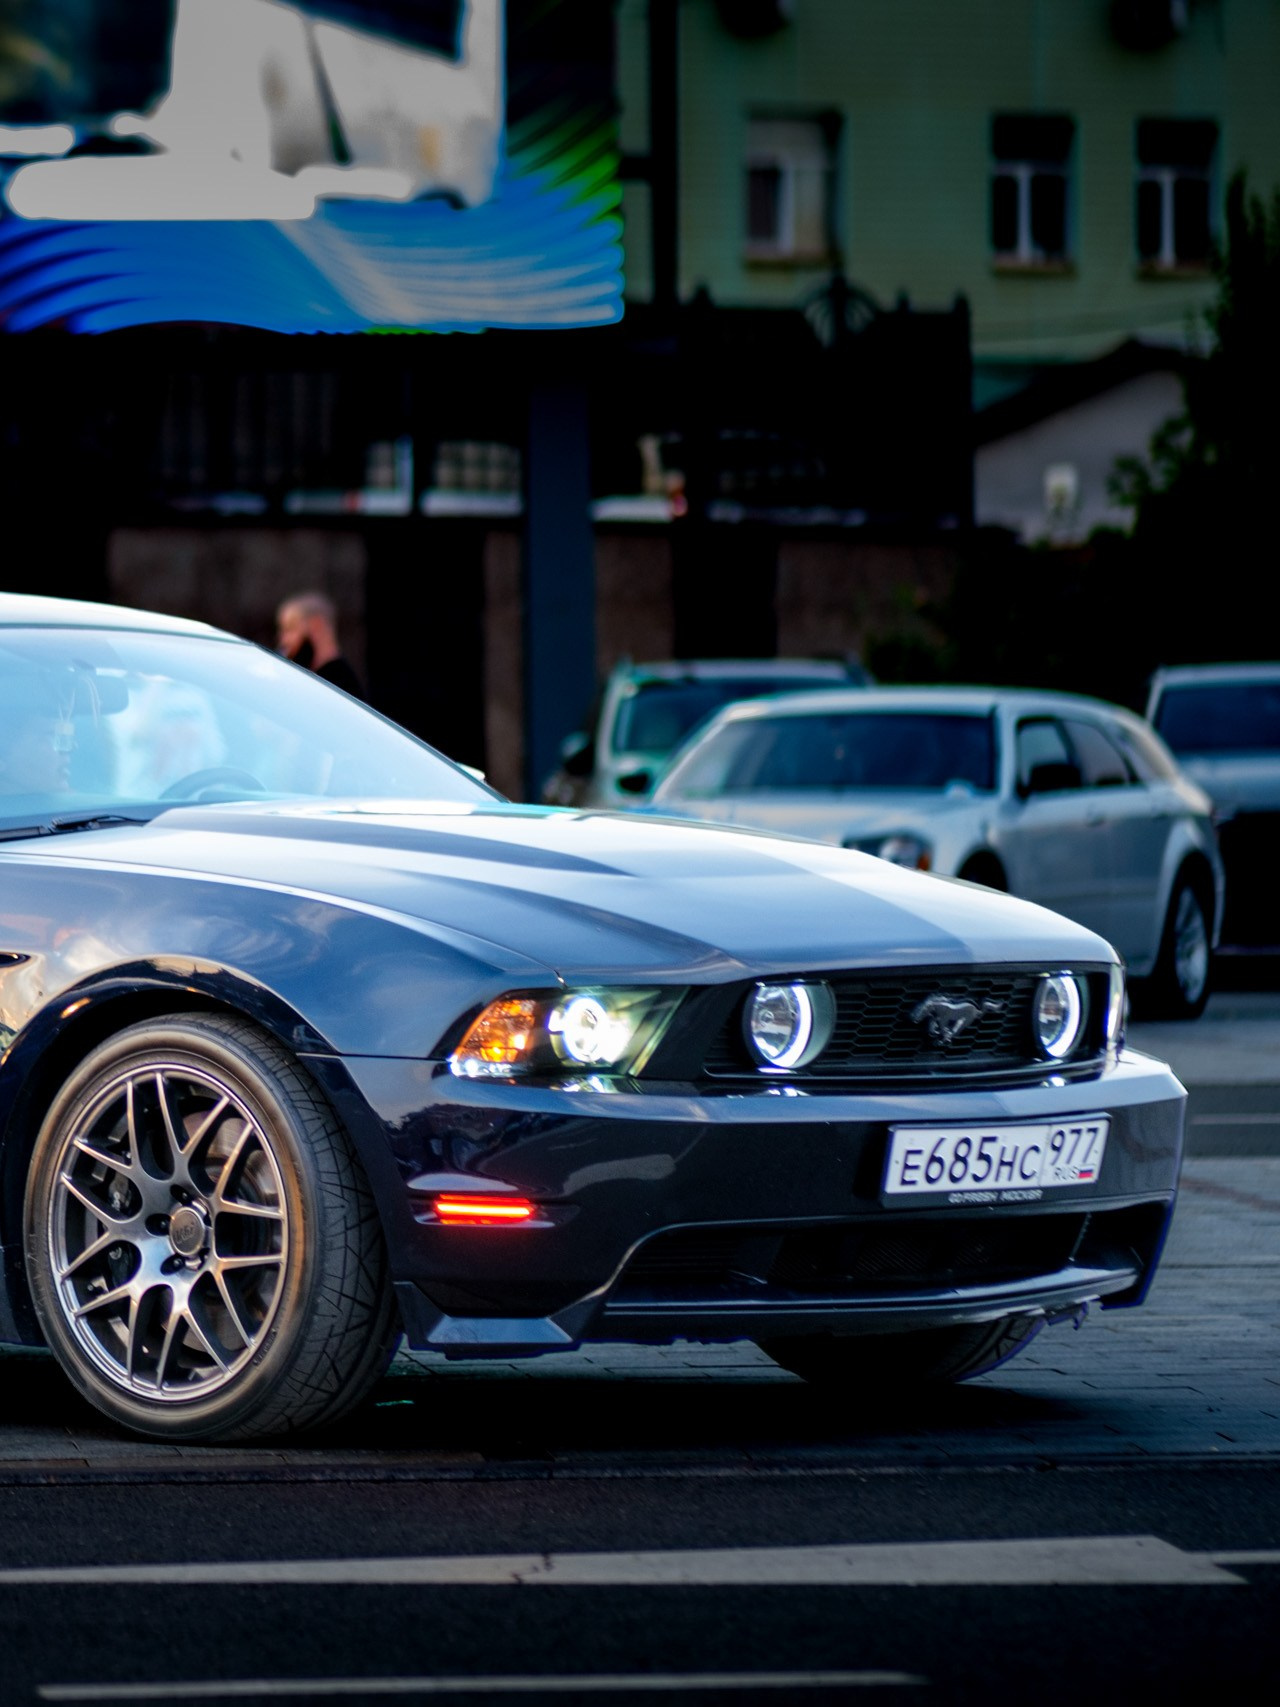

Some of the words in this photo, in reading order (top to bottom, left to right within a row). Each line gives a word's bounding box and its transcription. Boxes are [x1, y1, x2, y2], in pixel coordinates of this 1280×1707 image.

[900, 1136, 1041, 1186] E685HC
[1050, 1126, 1099, 1166] 977
[1052, 1165, 1080, 1181] RUS
